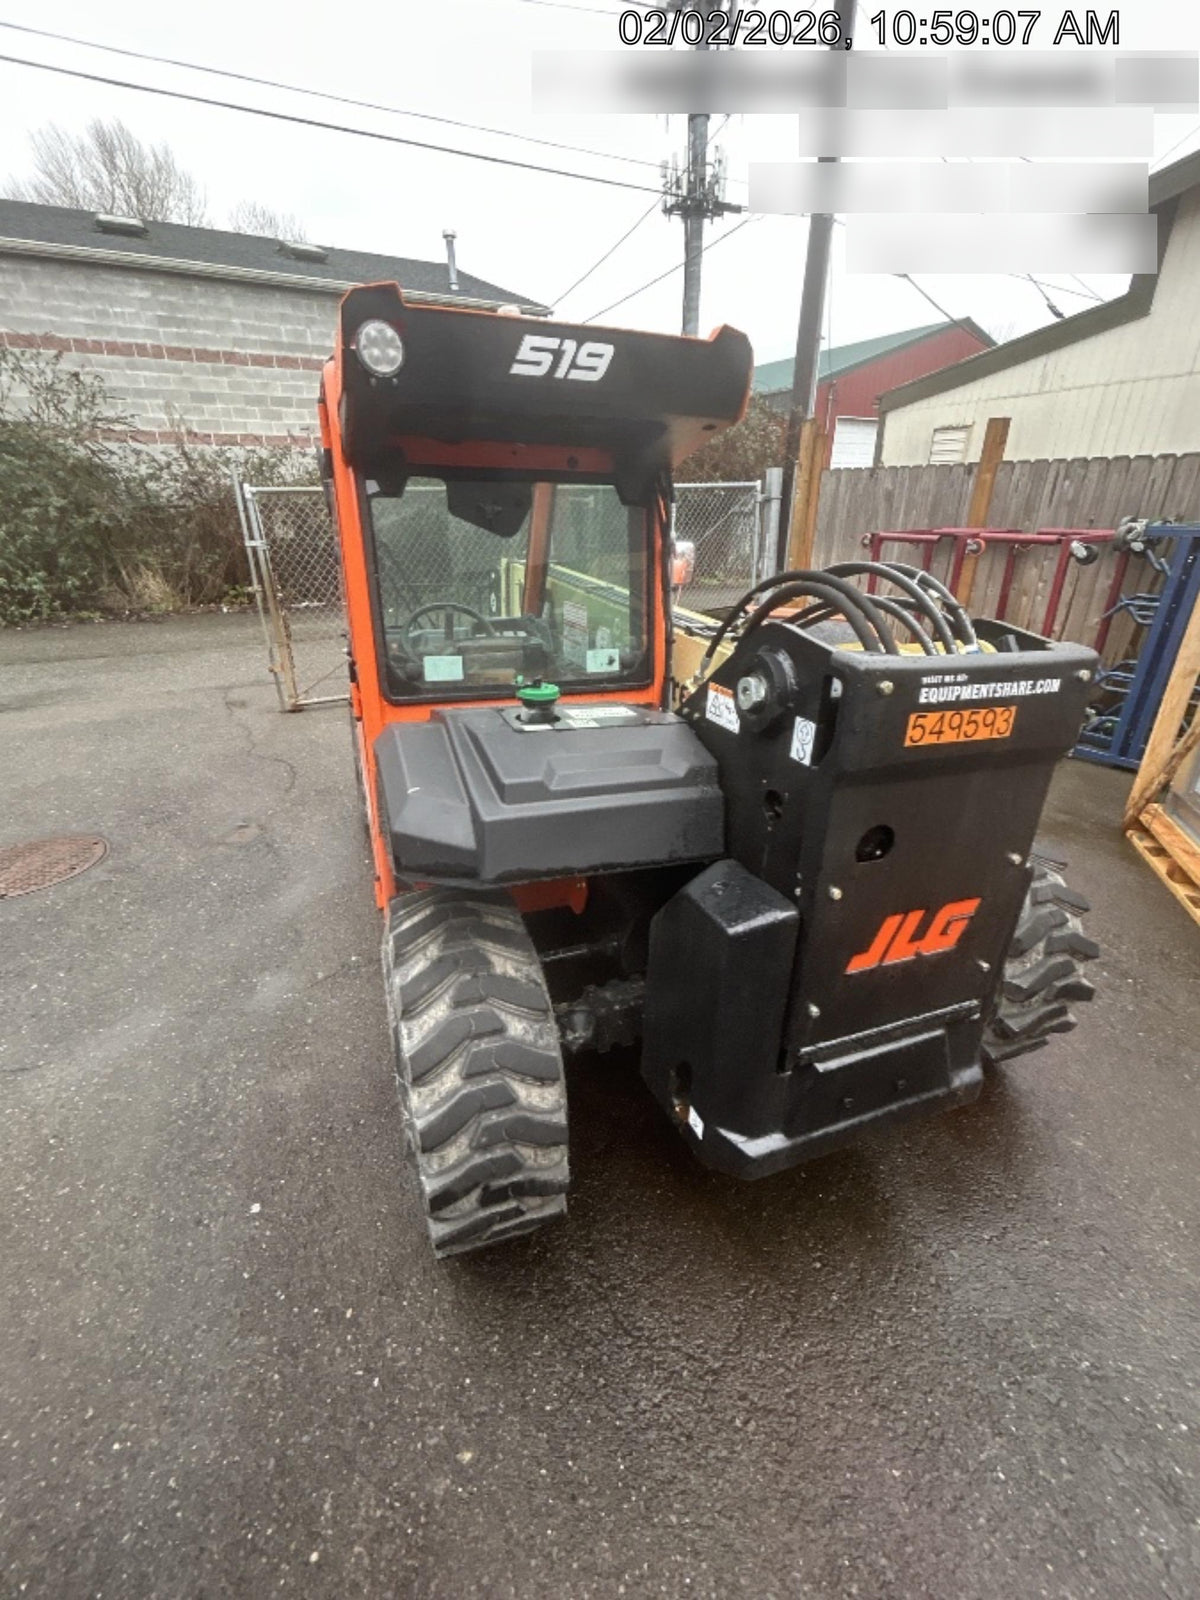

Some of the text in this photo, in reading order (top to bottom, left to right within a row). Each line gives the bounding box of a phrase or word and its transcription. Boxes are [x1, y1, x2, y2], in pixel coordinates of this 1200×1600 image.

[509, 334, 615, 381] 519
[919, 679, 1061, 703] EQUIPMENTSHARE.COM
[909, 708, 1012, 743] 549593
[844, 897, 982, 974] JLG
